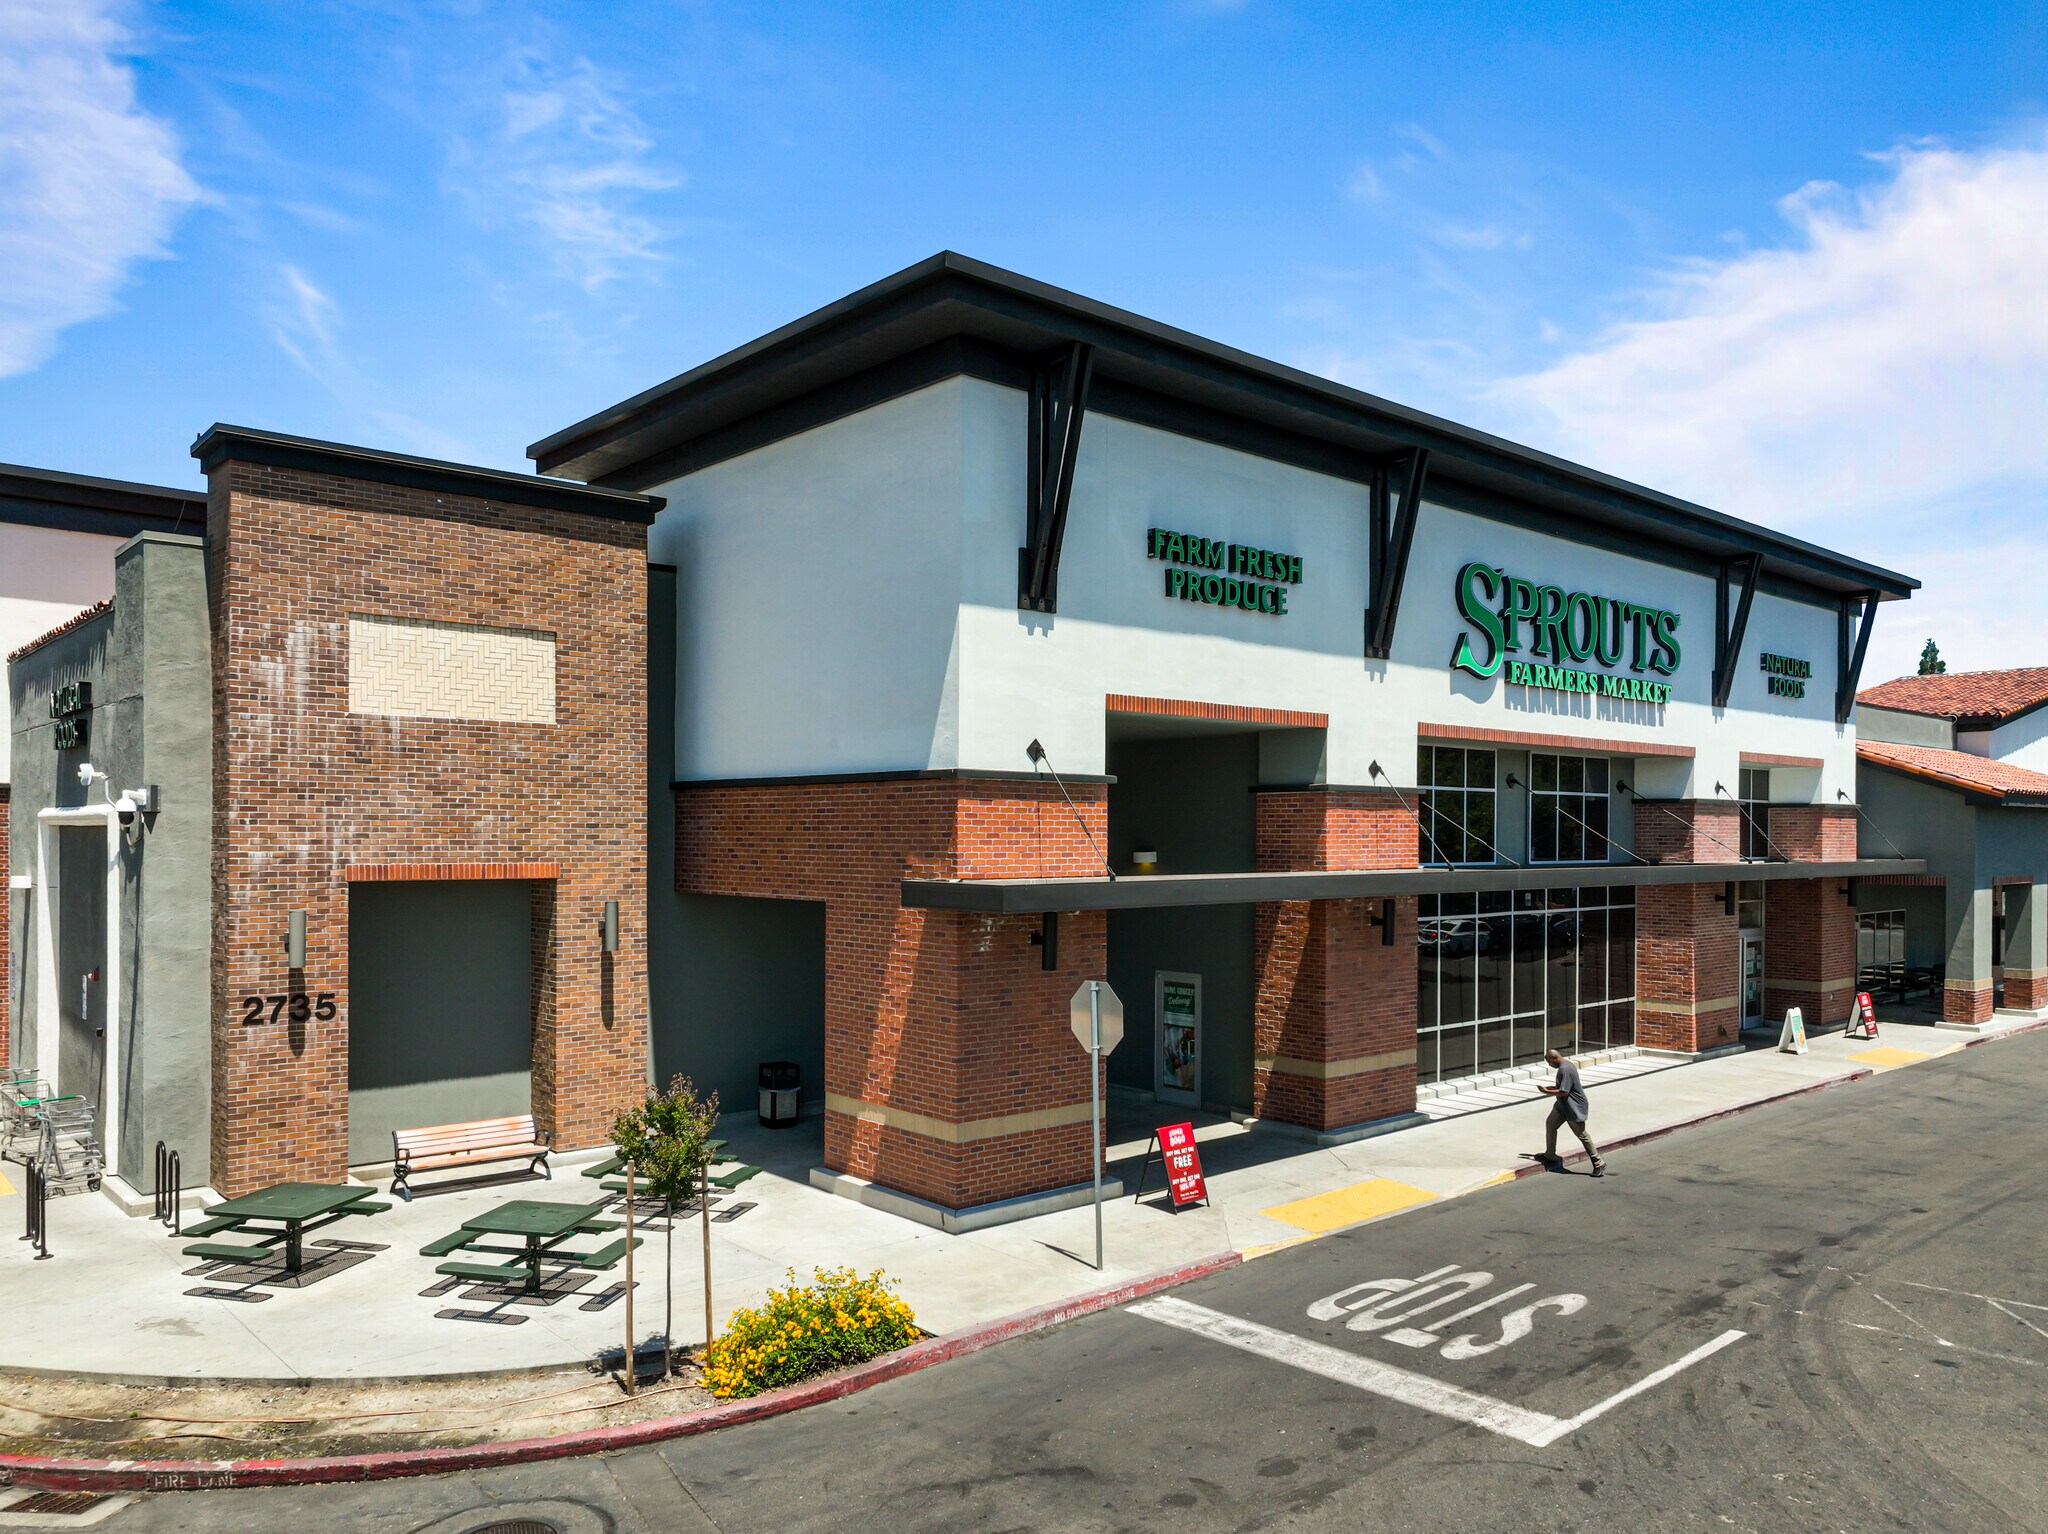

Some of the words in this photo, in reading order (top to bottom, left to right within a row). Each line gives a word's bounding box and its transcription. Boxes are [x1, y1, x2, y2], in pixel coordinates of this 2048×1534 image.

[1148, 528, 1225, 570] FARM
[1228, 544, 1303, 584] FRESH
[1165, 568, 1288, 615] PRODUCE
[1450, 562, 1681, 680] SPROUTS
[1504, 660, 1599, 694] FARMERS
[1602, 674, 1673, 704] MARKET
[1760, 653, 1812, 678] NATURAL
[1768, 677, 1806, 698] FOODS
[242, 993, 336, 1026] 2735
[1174, 1154, 1192, 1168] FREE
[1054, 1312, 1066, 1324] NO
[1306, 1264, 1588, 1360] STOP
[154, 1474, 191, 1488] FIRE
[198, 1473, 238, 1488] LANE
